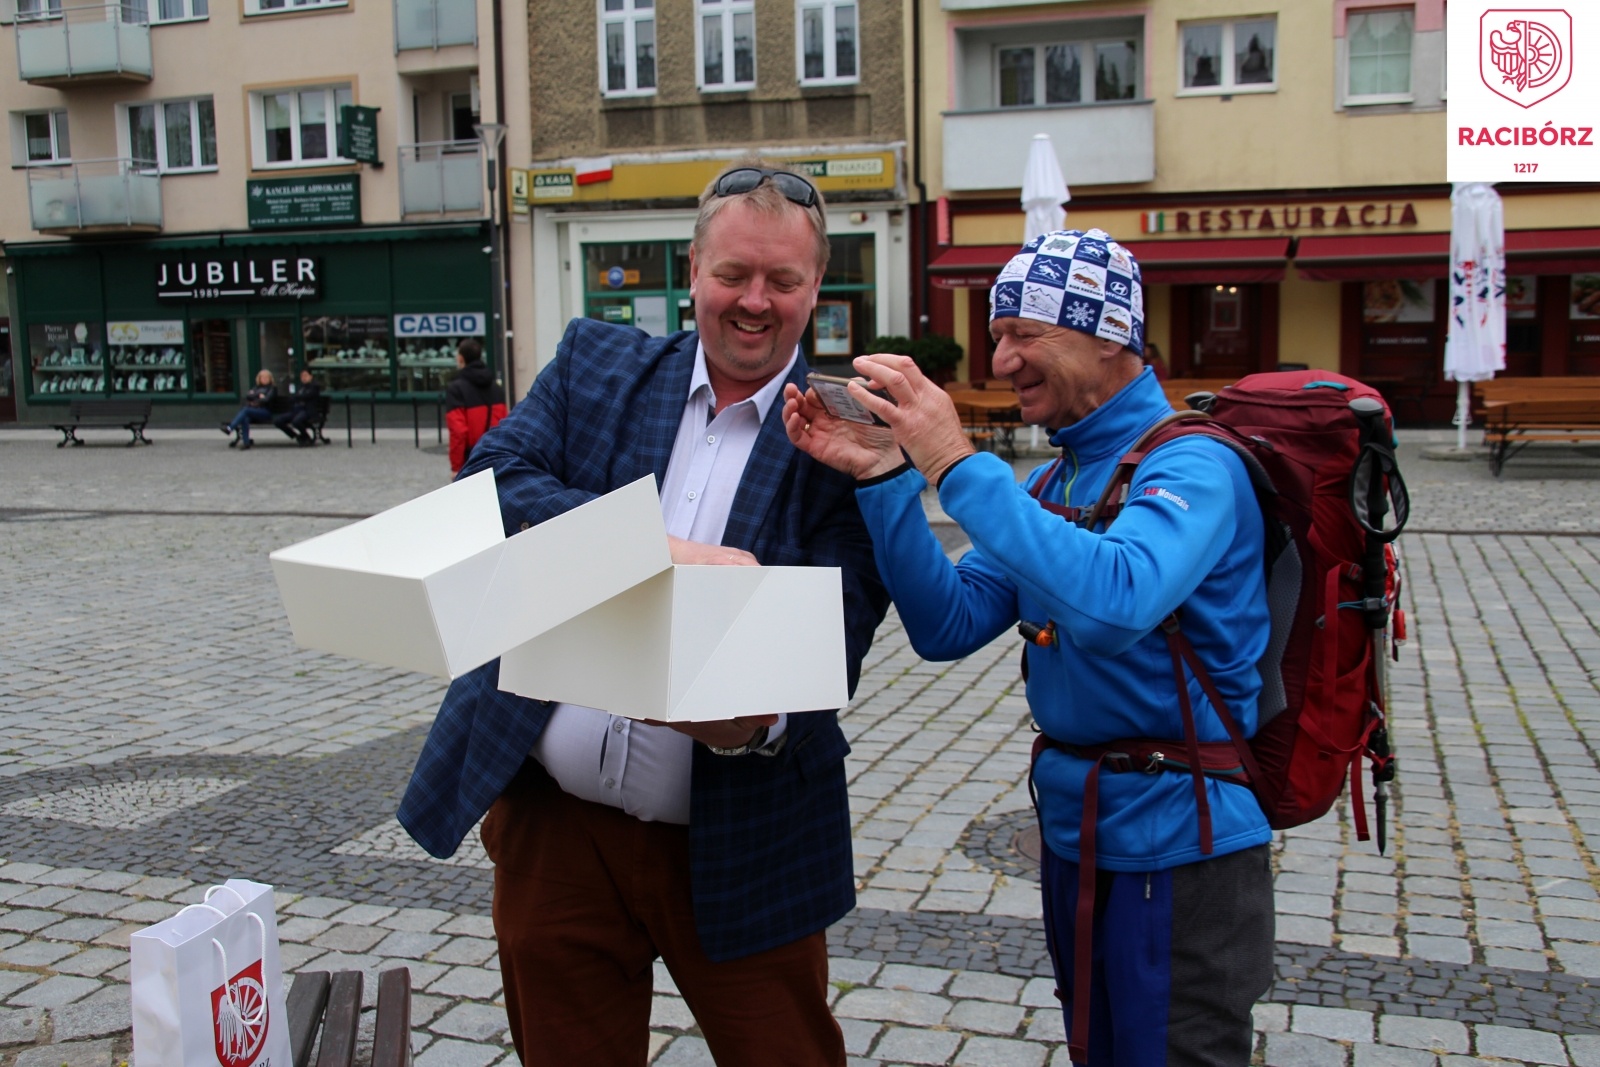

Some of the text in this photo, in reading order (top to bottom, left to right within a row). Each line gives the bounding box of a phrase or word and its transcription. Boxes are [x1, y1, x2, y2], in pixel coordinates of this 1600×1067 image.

[545, 174, 572, 186] KASA
[1175, 203, 1418, 233] RESTAURACJA
[157, 258, 316, 286] JUBILER
[193, 288, 220, 298] 1989
[399, 314, 478, 334] CASIO
